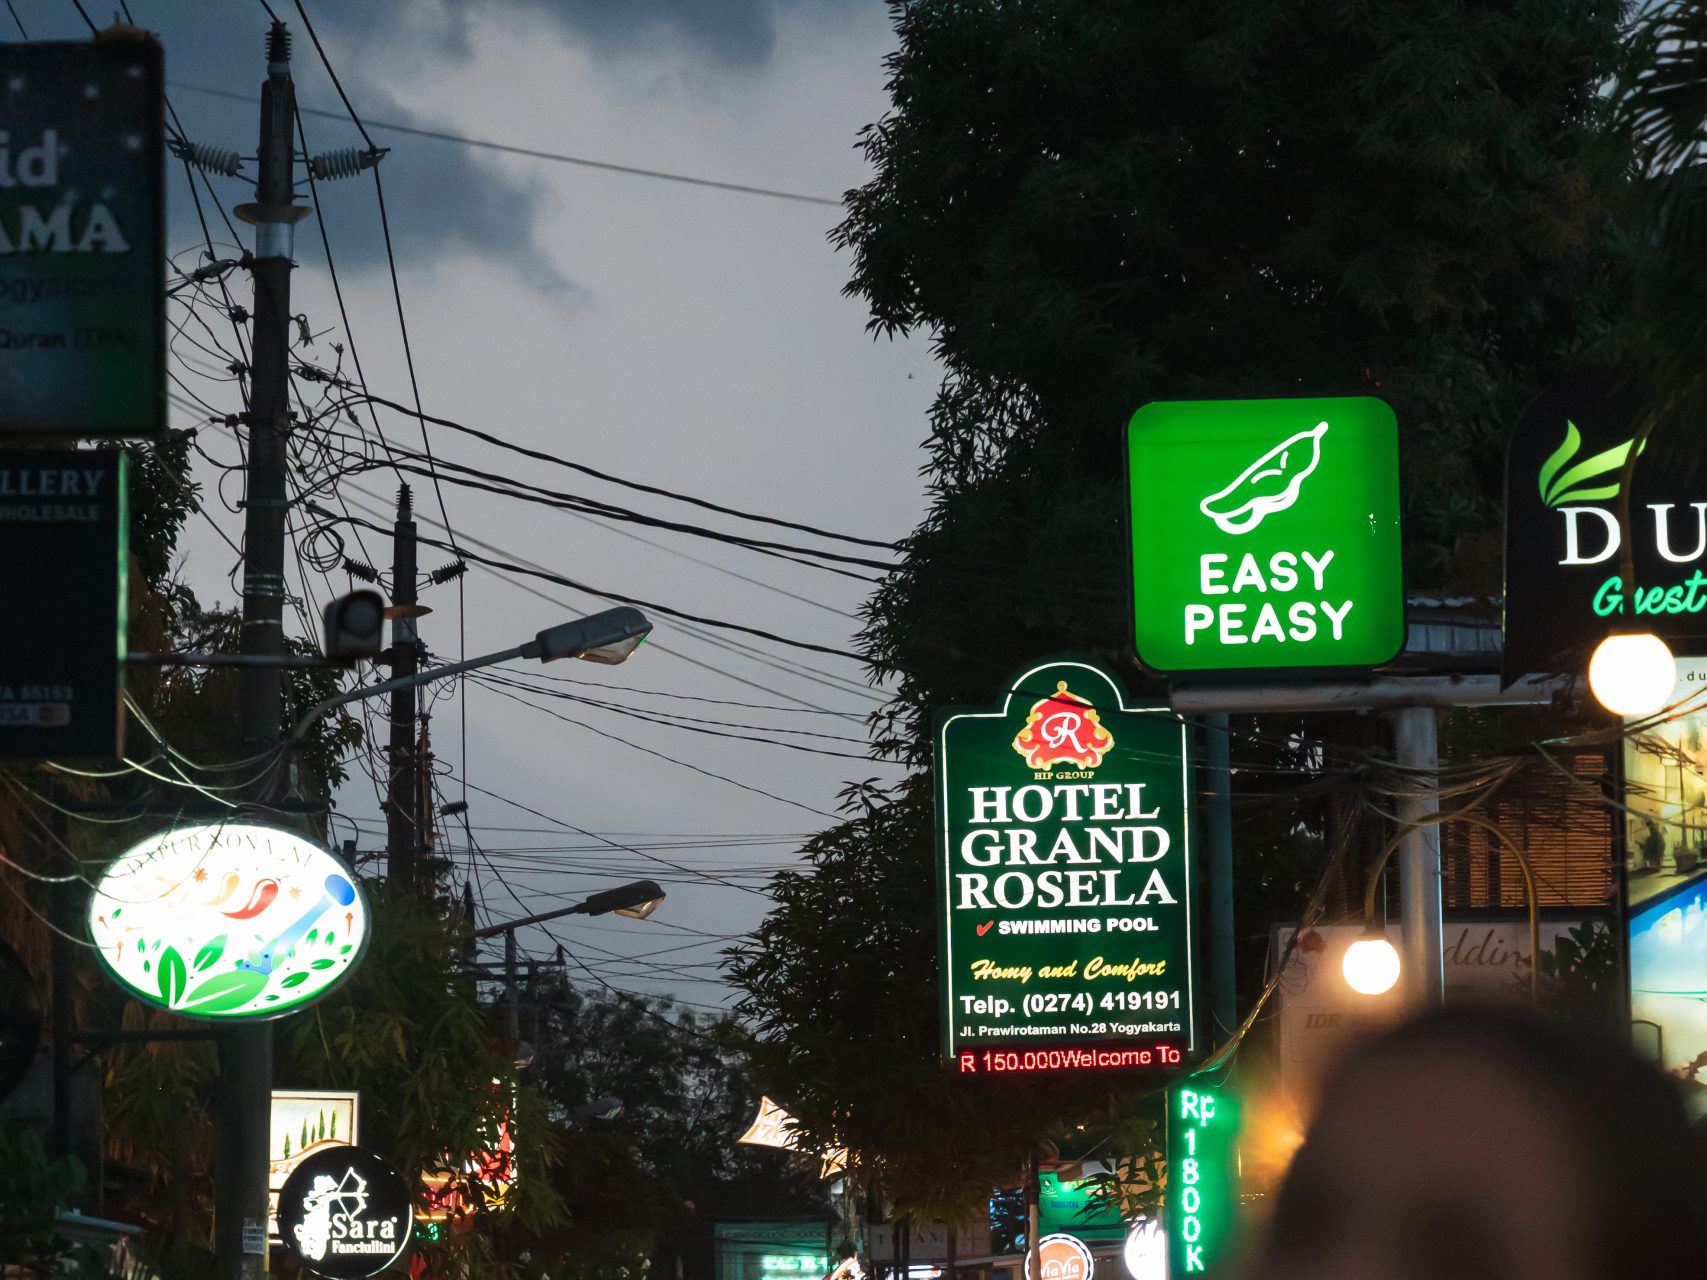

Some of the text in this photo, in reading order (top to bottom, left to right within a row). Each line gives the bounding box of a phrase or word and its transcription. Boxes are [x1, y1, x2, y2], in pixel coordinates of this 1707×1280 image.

[1200, 550, 1335, 594] EASY
[1185, 600, 1353, 645] PEASY
[1034, 771, 1095, 780] HIP GROUP
[968, 783, 1160, 823] HOTEL
[961, 826, 1170, 866] GRAND
[956, 868, 1178, 909] ROSELA
[998, 917, 1159, 934] SWIMMING POOL
[971, 956, 1166, 983] Homy and Comfort
[960, 990, 1181, 1018] Telp. (0274) 419191
[979, 1025, 1067, 1037] Prawirotaman
[1070, 1023, 1107, 1034] No.28
[1109, 1021, 1181, 1035] Yogyakarta
[1156, 1046, 1181, 1063] To
[332, 1213, 396, 1239] Sara
